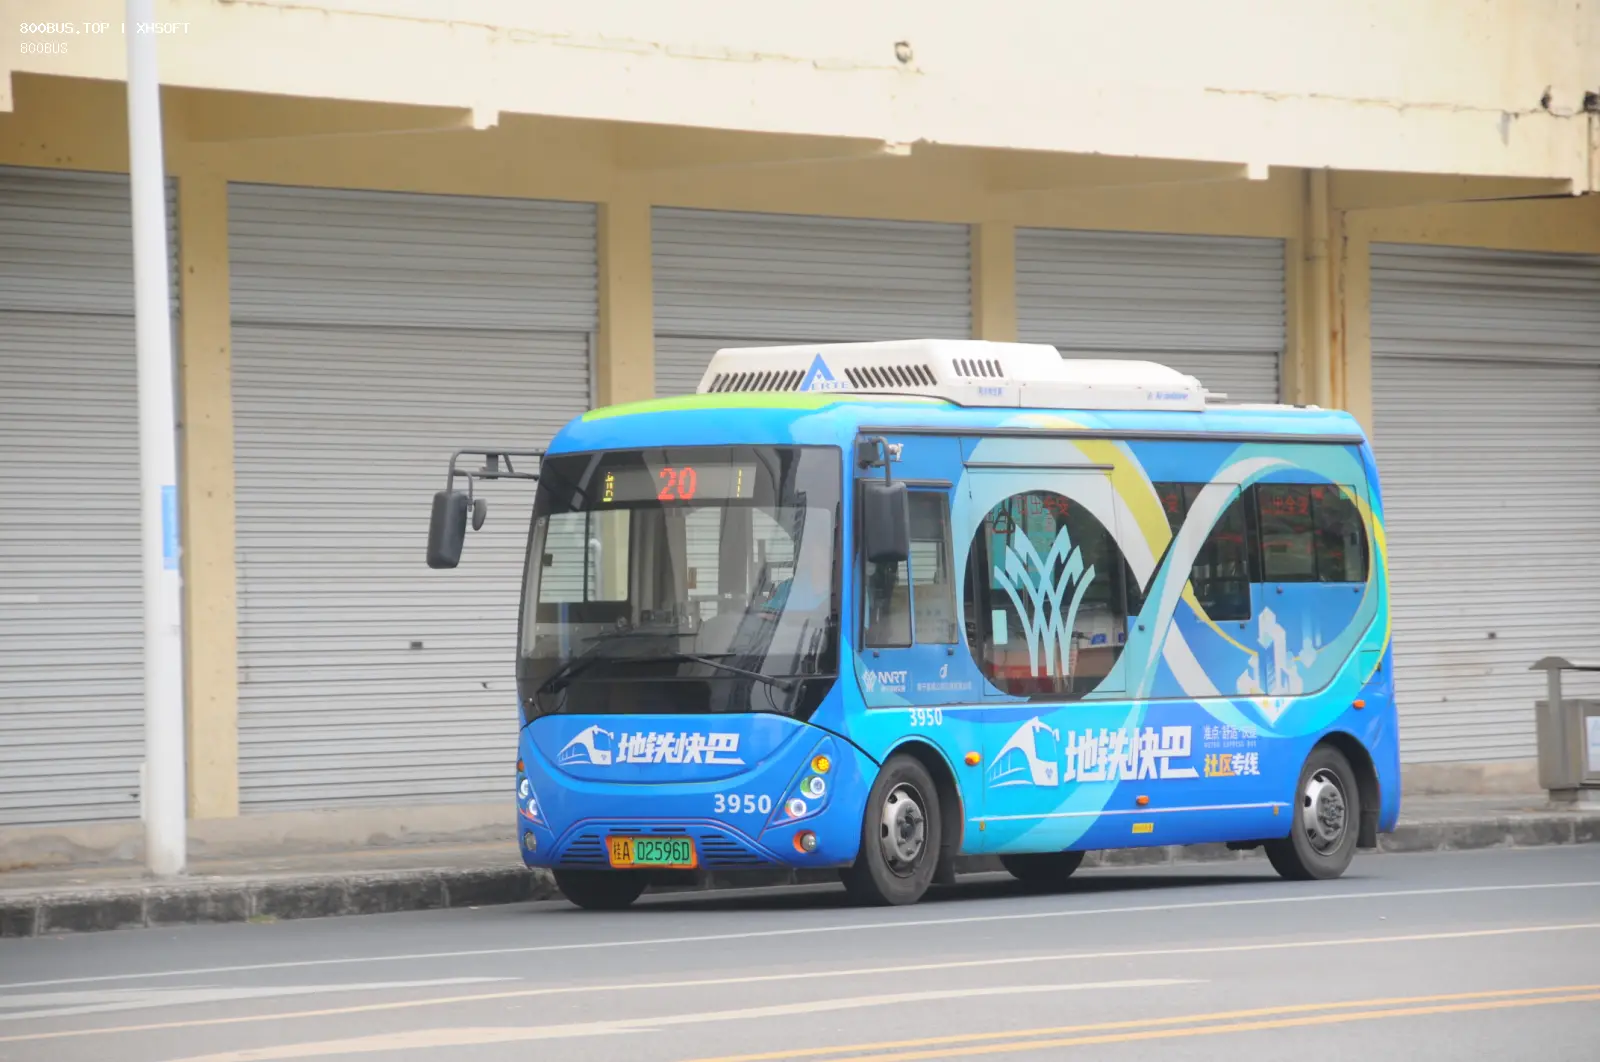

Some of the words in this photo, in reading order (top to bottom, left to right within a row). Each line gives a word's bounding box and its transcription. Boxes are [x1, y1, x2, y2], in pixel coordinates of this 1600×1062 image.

[657, 466, 697, 501] 20
[909, 707, 943, 727] 3950
[615, 732, 746, 765] 地铁快巴
[1064, 725, 1200, 782] 地铁快巴
[1203, 752, 1260, 778] 社区专线
[713, 794, 772, 814] 3950
